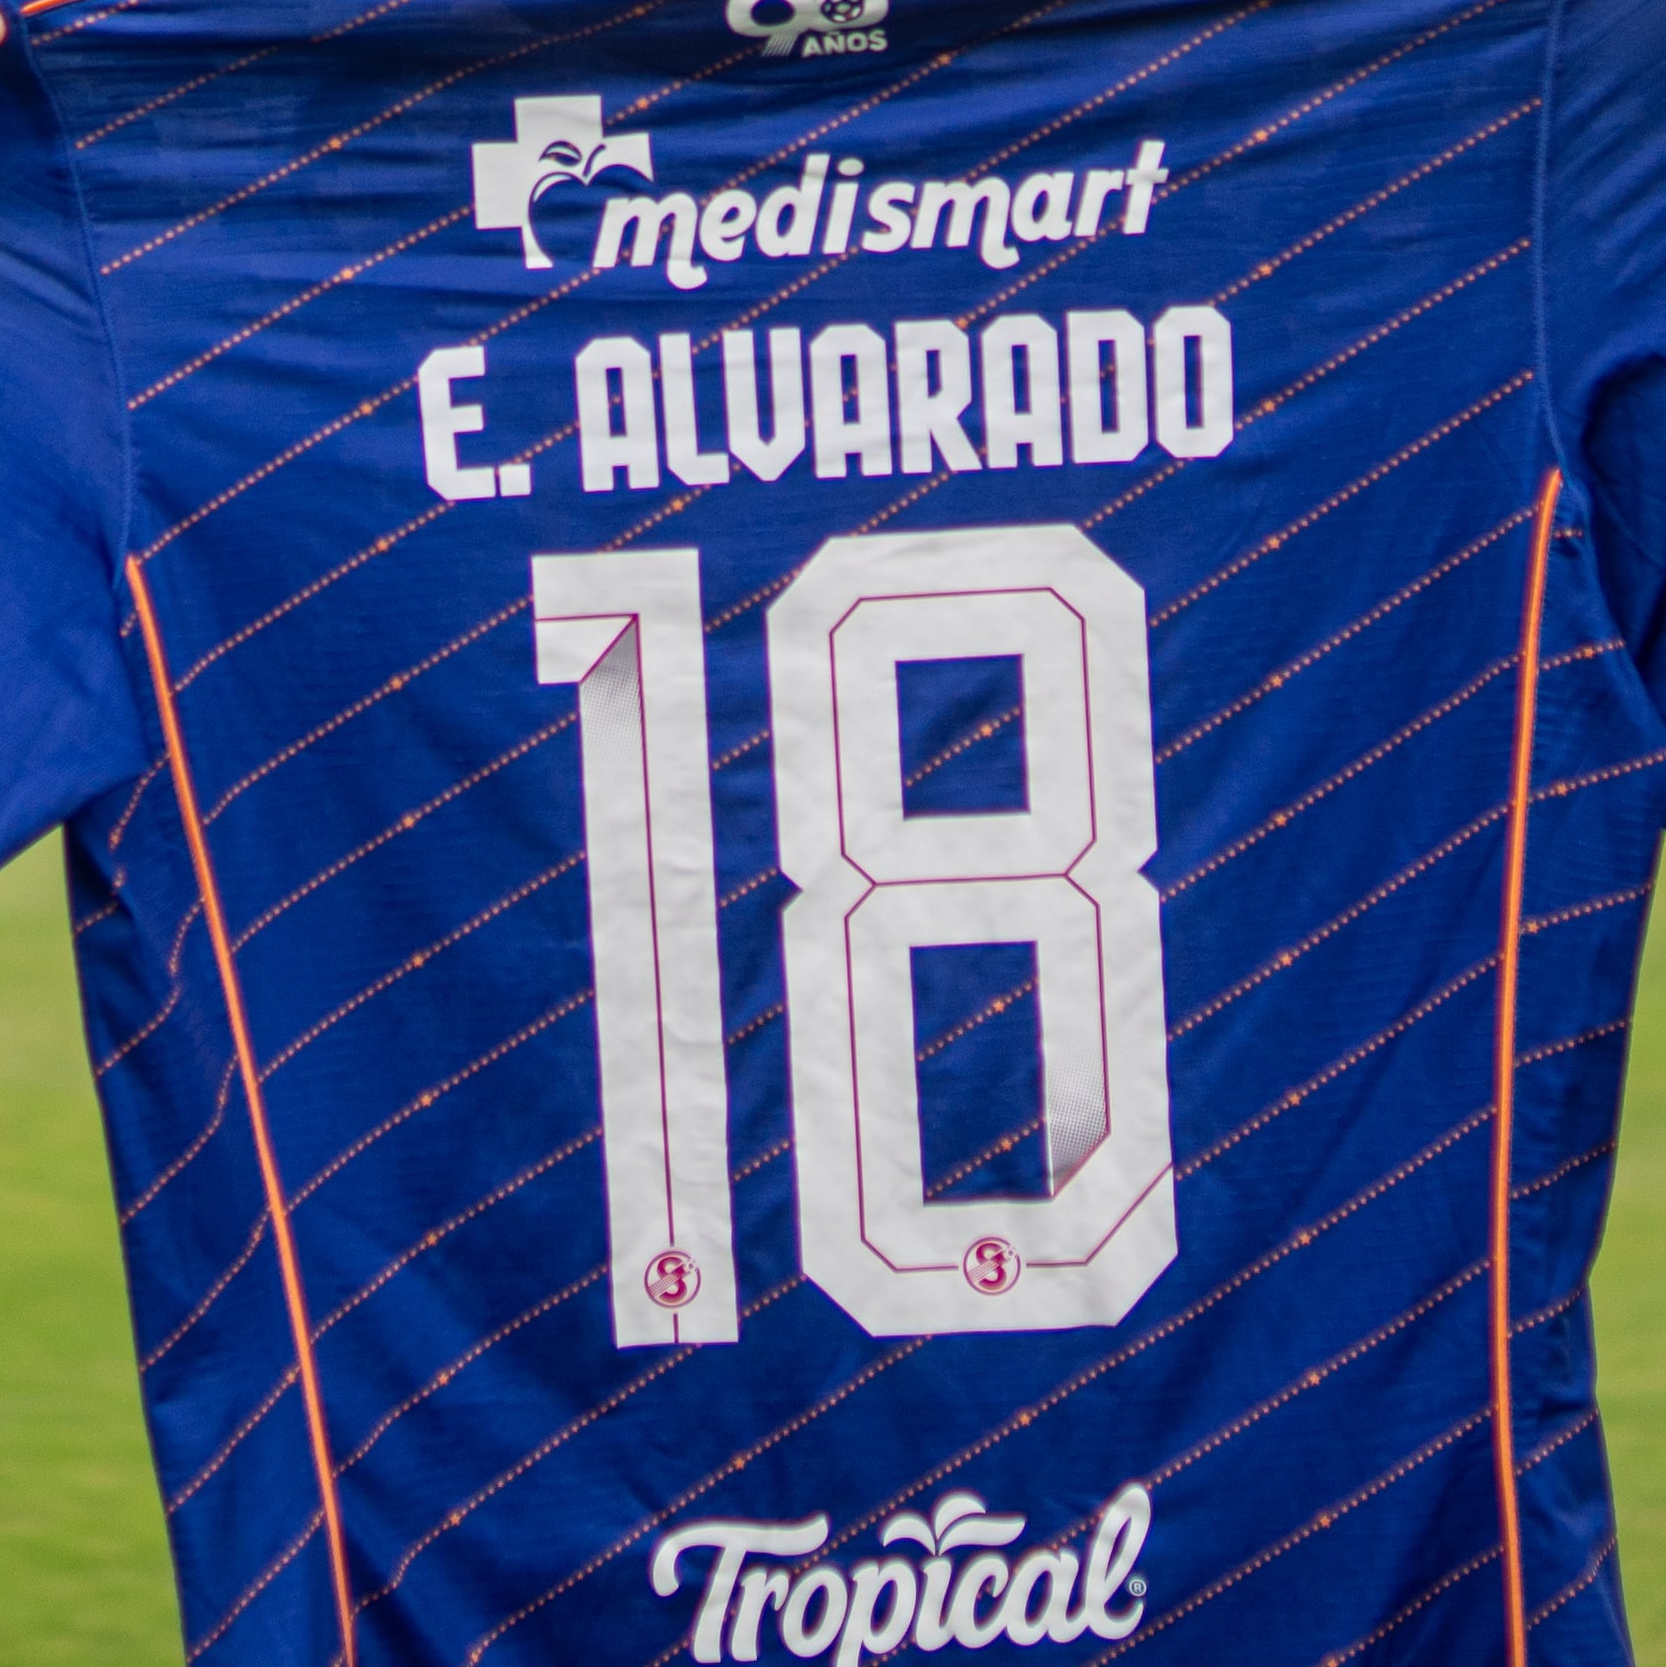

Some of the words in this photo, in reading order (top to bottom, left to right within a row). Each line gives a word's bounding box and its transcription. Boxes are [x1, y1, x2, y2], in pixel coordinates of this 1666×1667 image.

[802, 29, 888, 58] AÑOS
[593, 140, 1169, 289] medismart
[417, 345, 531, 500] E.
[575, 306, 1234, 492] ALVARADO
[531, 524, 1178, 1349] 18
[652, 1481, 1151, 1667] Tropical
